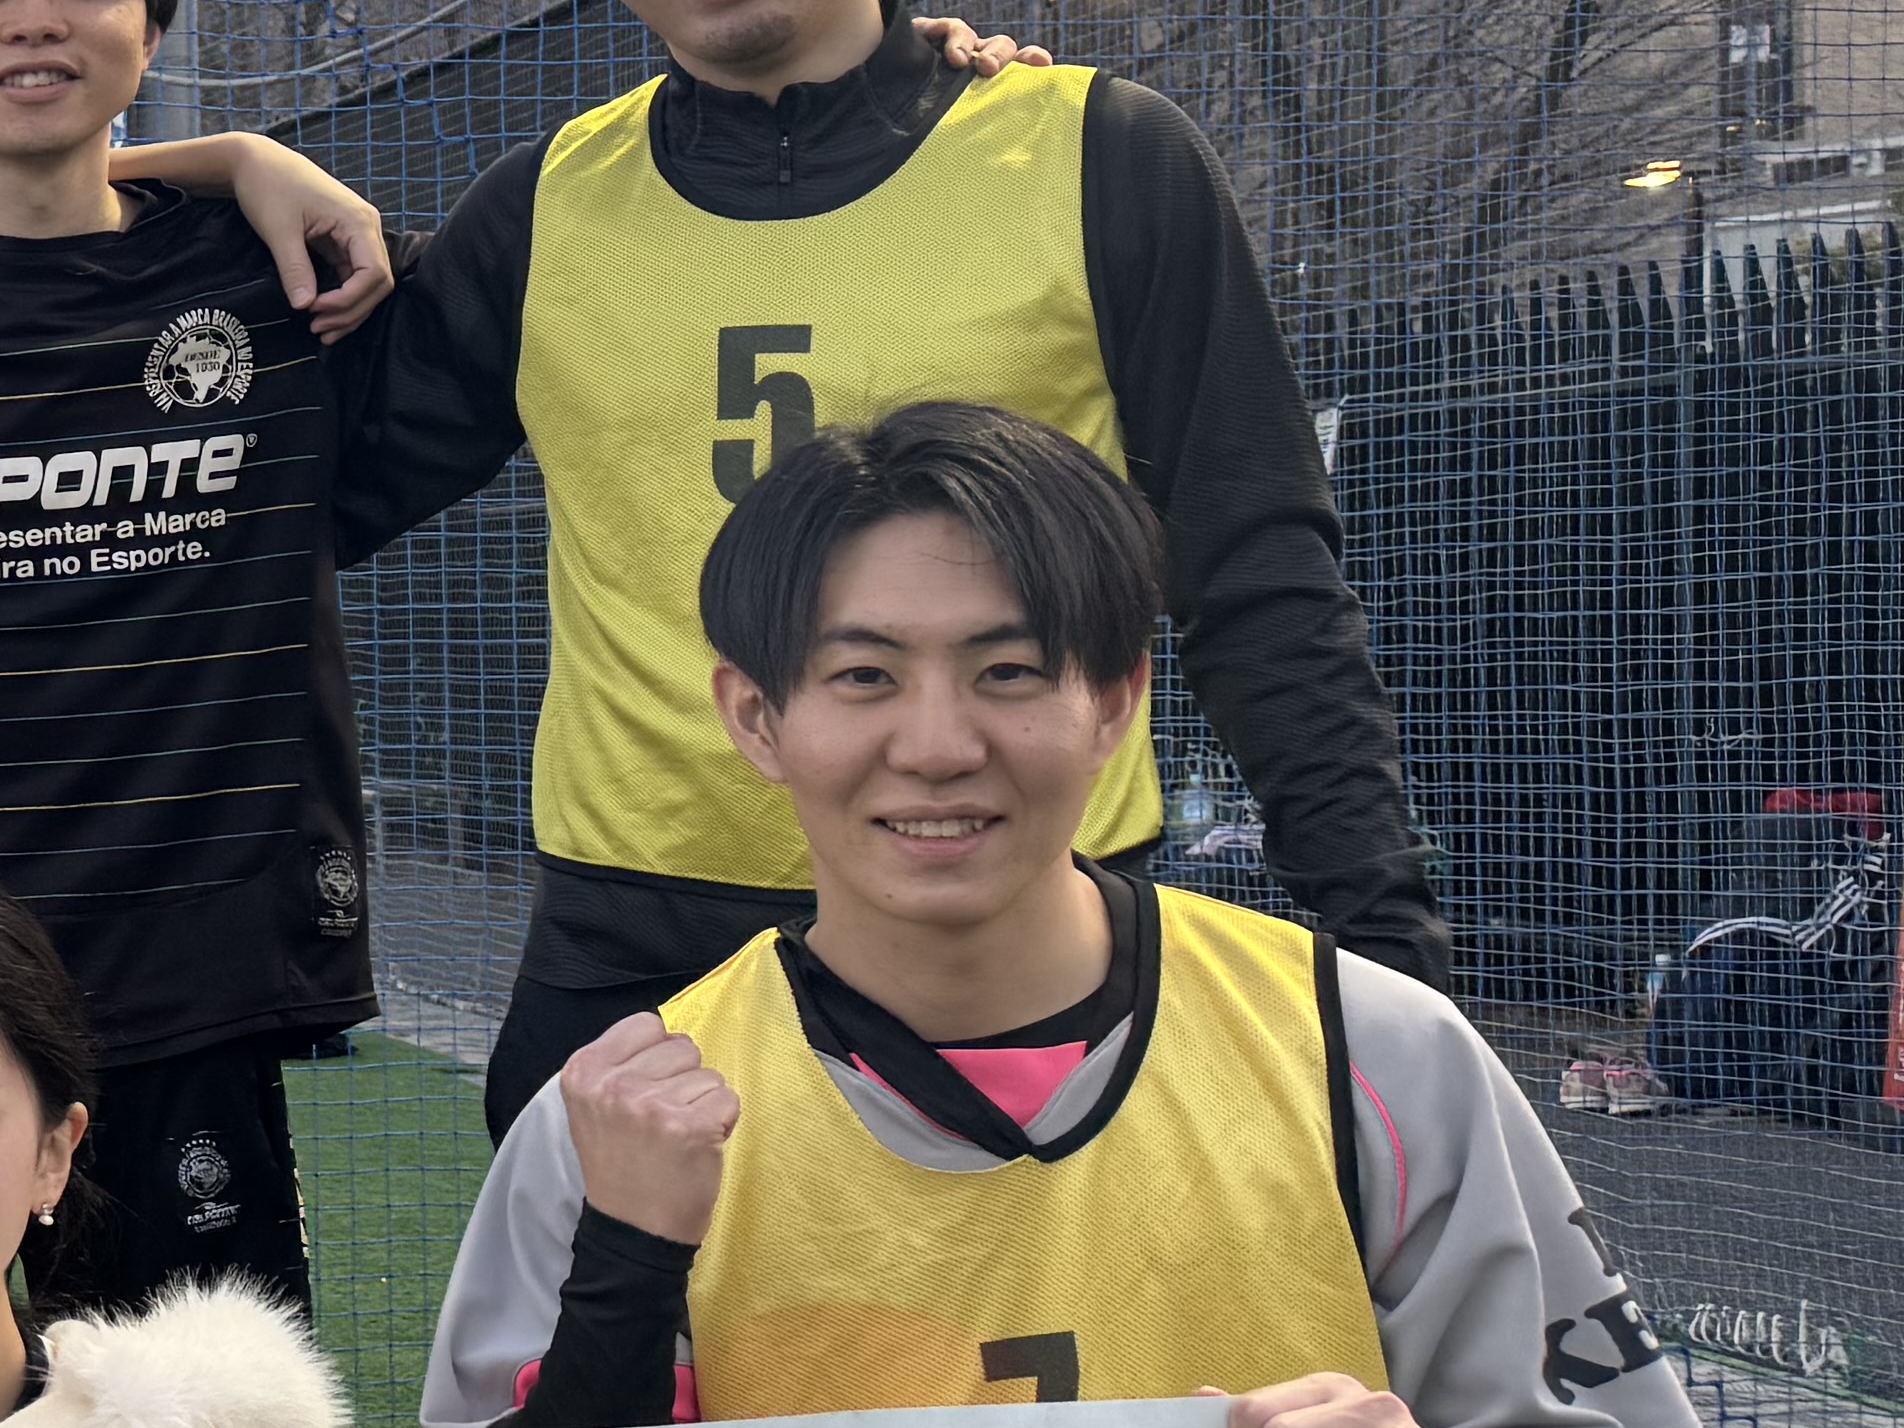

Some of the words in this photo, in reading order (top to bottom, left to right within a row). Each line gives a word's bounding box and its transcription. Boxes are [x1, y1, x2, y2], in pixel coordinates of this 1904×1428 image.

[711, 323, 817, 505] 5
[116, 519, 135, 539] a
[144, 507, 227, 537] Marca
[43, 553, 81, 577] no
[90, 540, 211, 574] Esporte.
